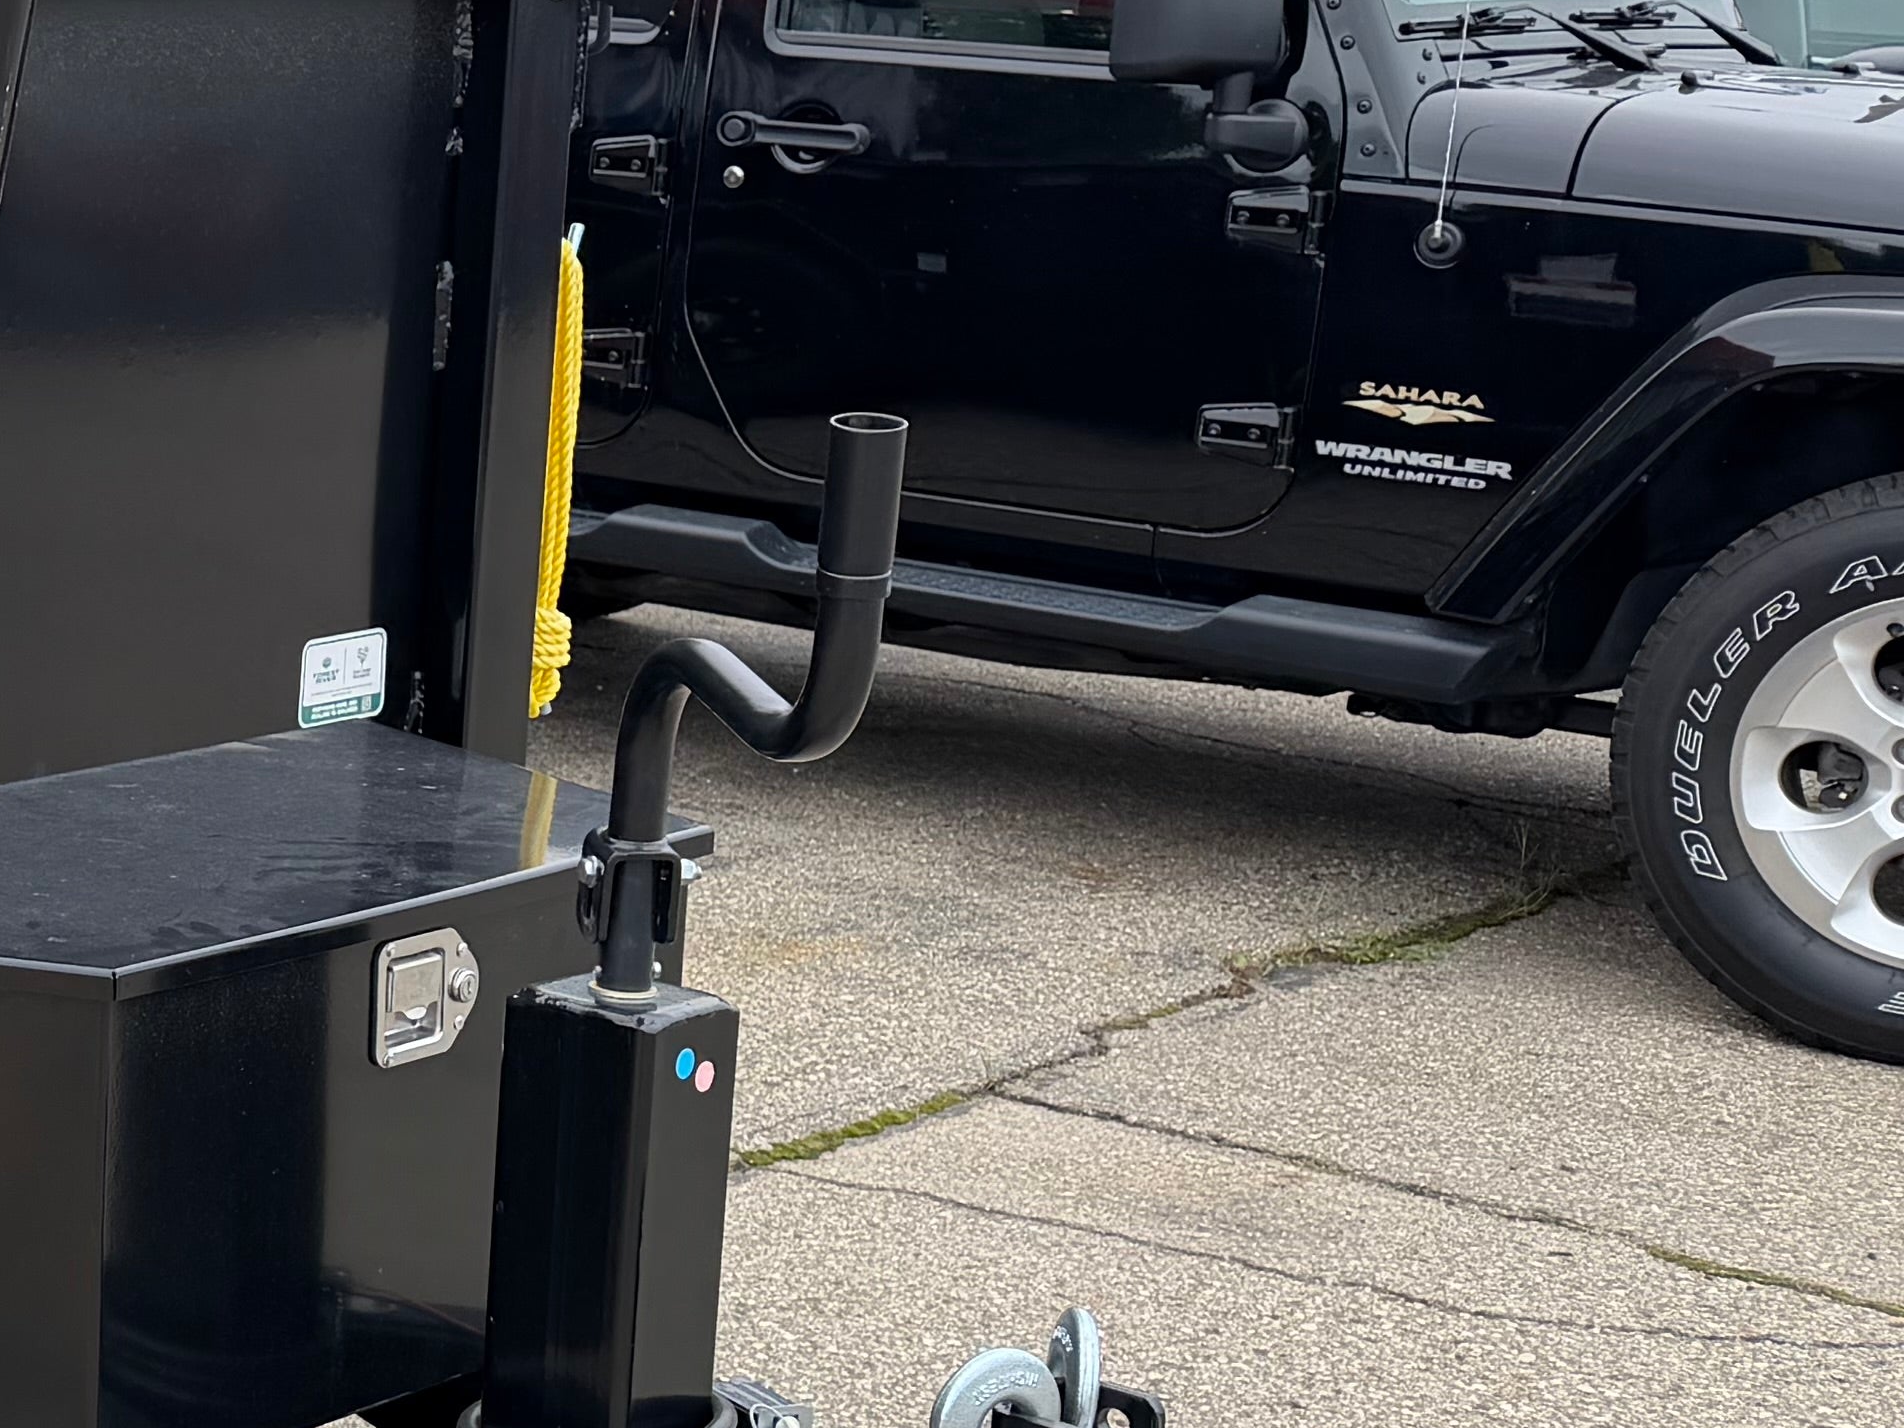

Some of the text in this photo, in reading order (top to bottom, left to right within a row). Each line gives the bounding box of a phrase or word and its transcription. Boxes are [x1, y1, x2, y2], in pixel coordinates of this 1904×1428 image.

[1359, 381, 1485, 410] SAHARA
[1315, 440, 1513, 480] WRANGLER
[1343, 463, 1487, 490] UNLIMITED
[1672, 589, 1800, 882] DUELER
